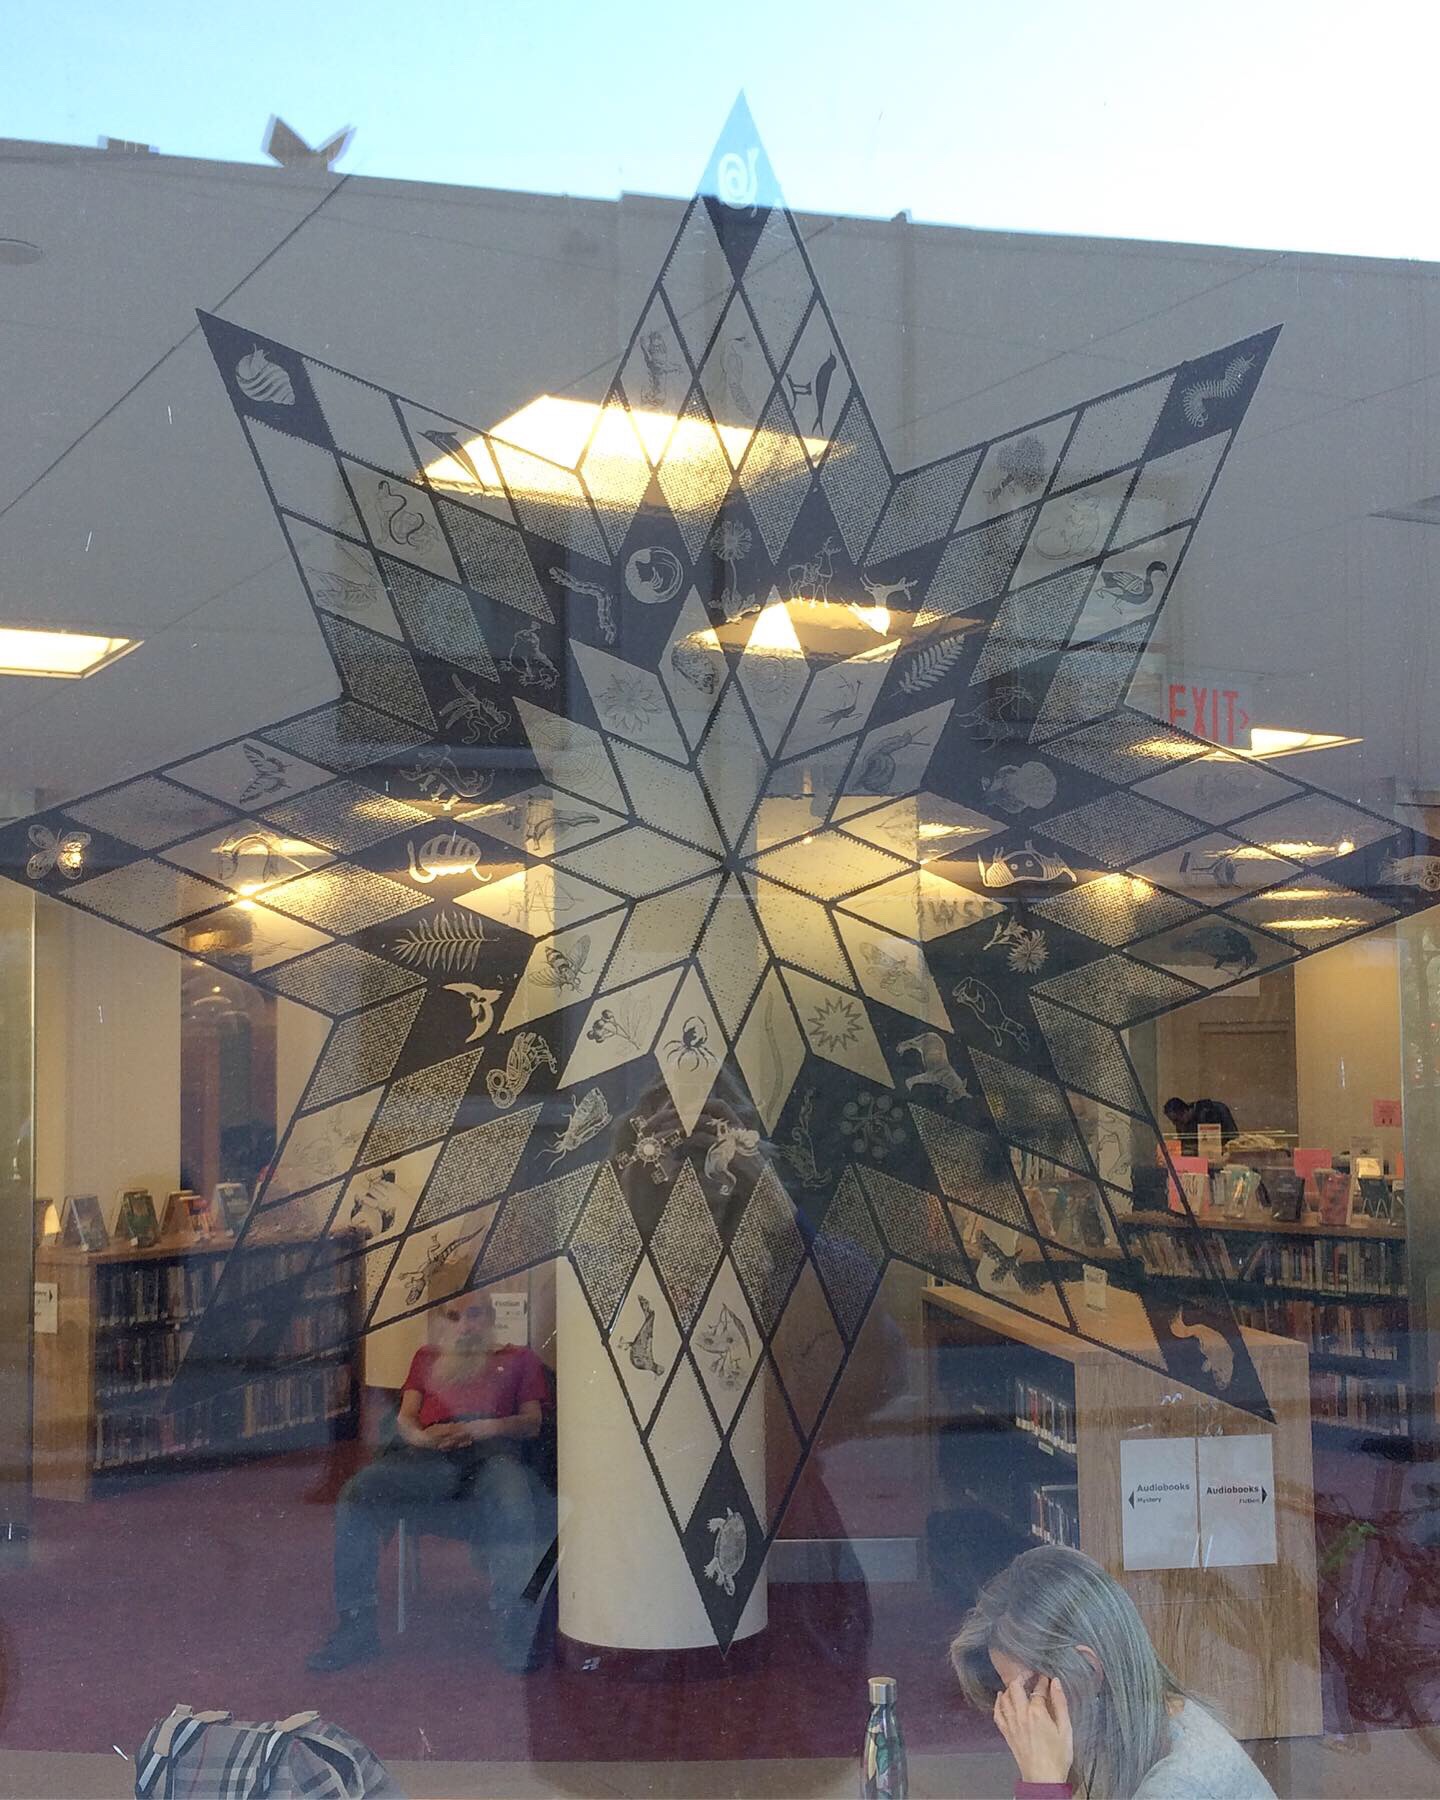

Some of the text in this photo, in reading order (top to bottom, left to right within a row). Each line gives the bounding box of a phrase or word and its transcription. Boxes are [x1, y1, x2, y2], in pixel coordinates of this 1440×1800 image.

[1169, 685, 1239, 744] EXIT
[1137, 1483, 1190, 1493] Audiobooks
[1206, 1485, 1259, 1495] Audiobooks
